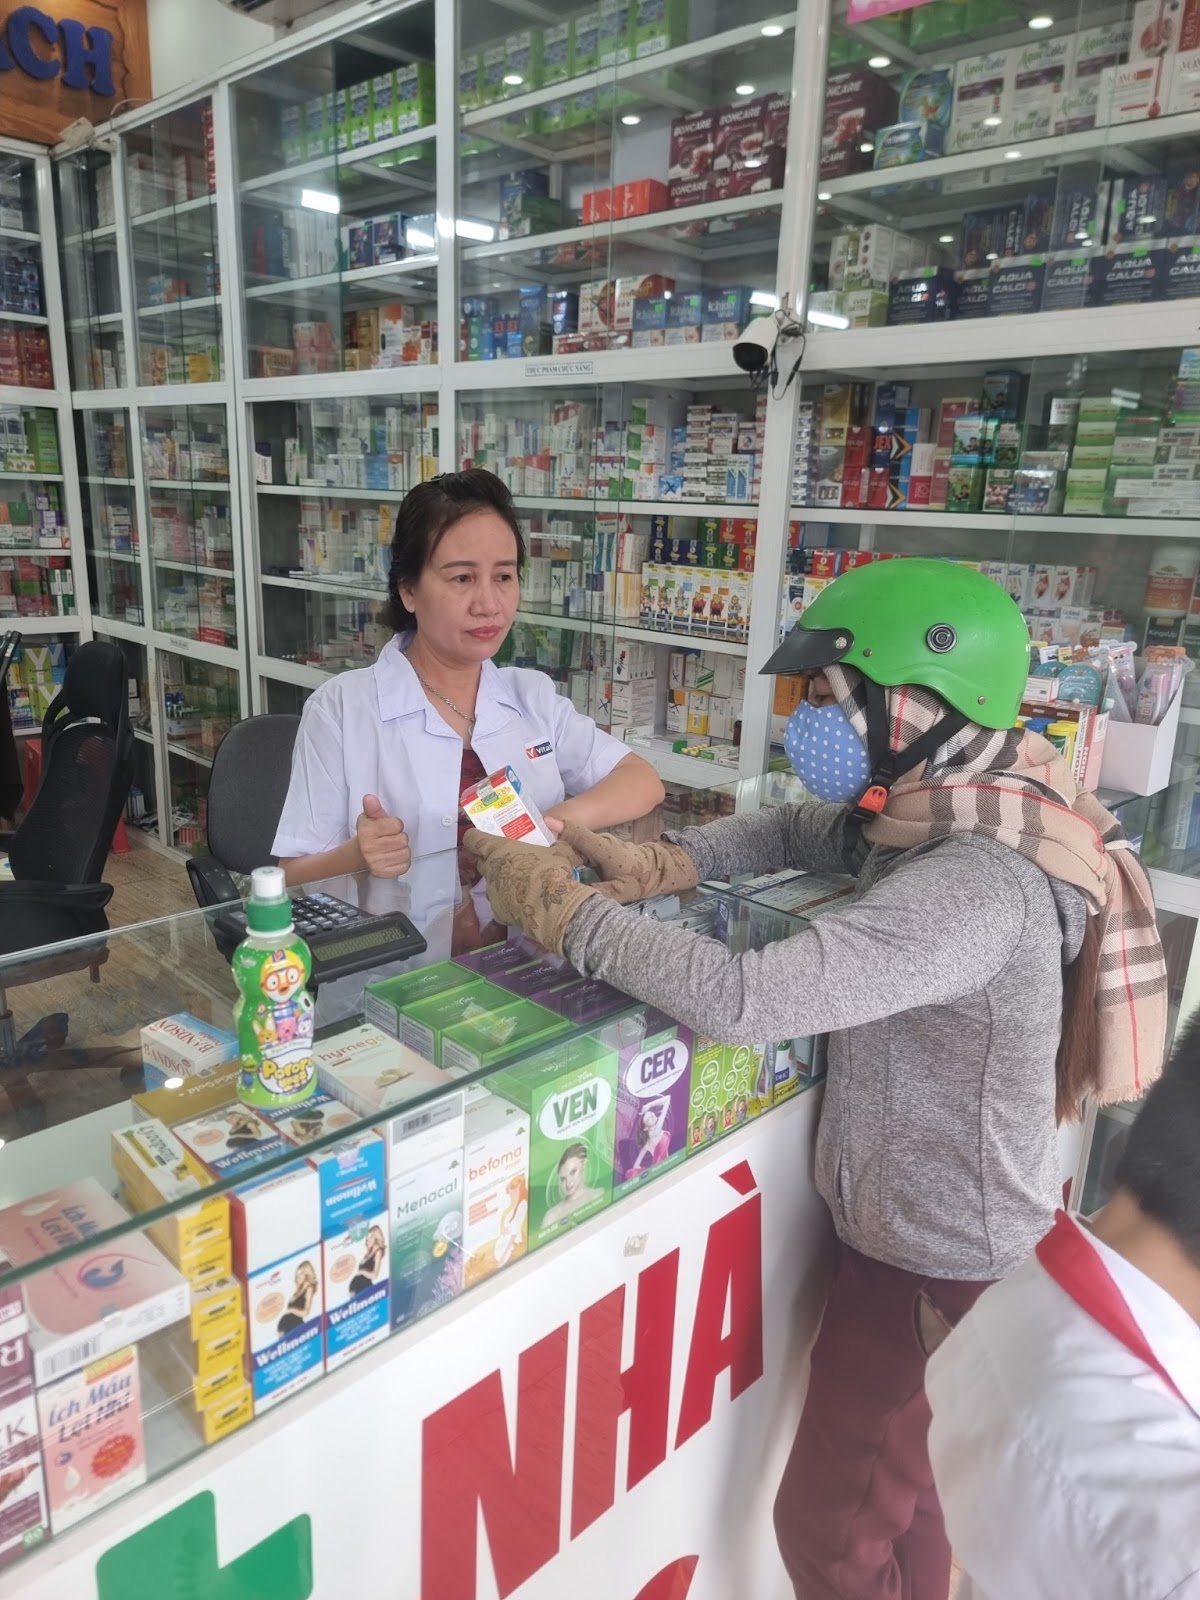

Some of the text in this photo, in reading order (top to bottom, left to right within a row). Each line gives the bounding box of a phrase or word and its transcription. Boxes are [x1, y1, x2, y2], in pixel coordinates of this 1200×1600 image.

[0, 5, 116, 97] CH
[319, 1034, 387, 1062] hymega
[640, 1046, 676, 1084] CER
[552, 1083, 598, 1128] VEN
[468, 1145, 523, 1182] befoma
[396, 1177, 458, 1219] Menacal
[328, 1288, 388, 1326] Wellmom
[255, 1325, 320, 1368] Wellmom
[420, 1159, 764, 1600] NHÀ
